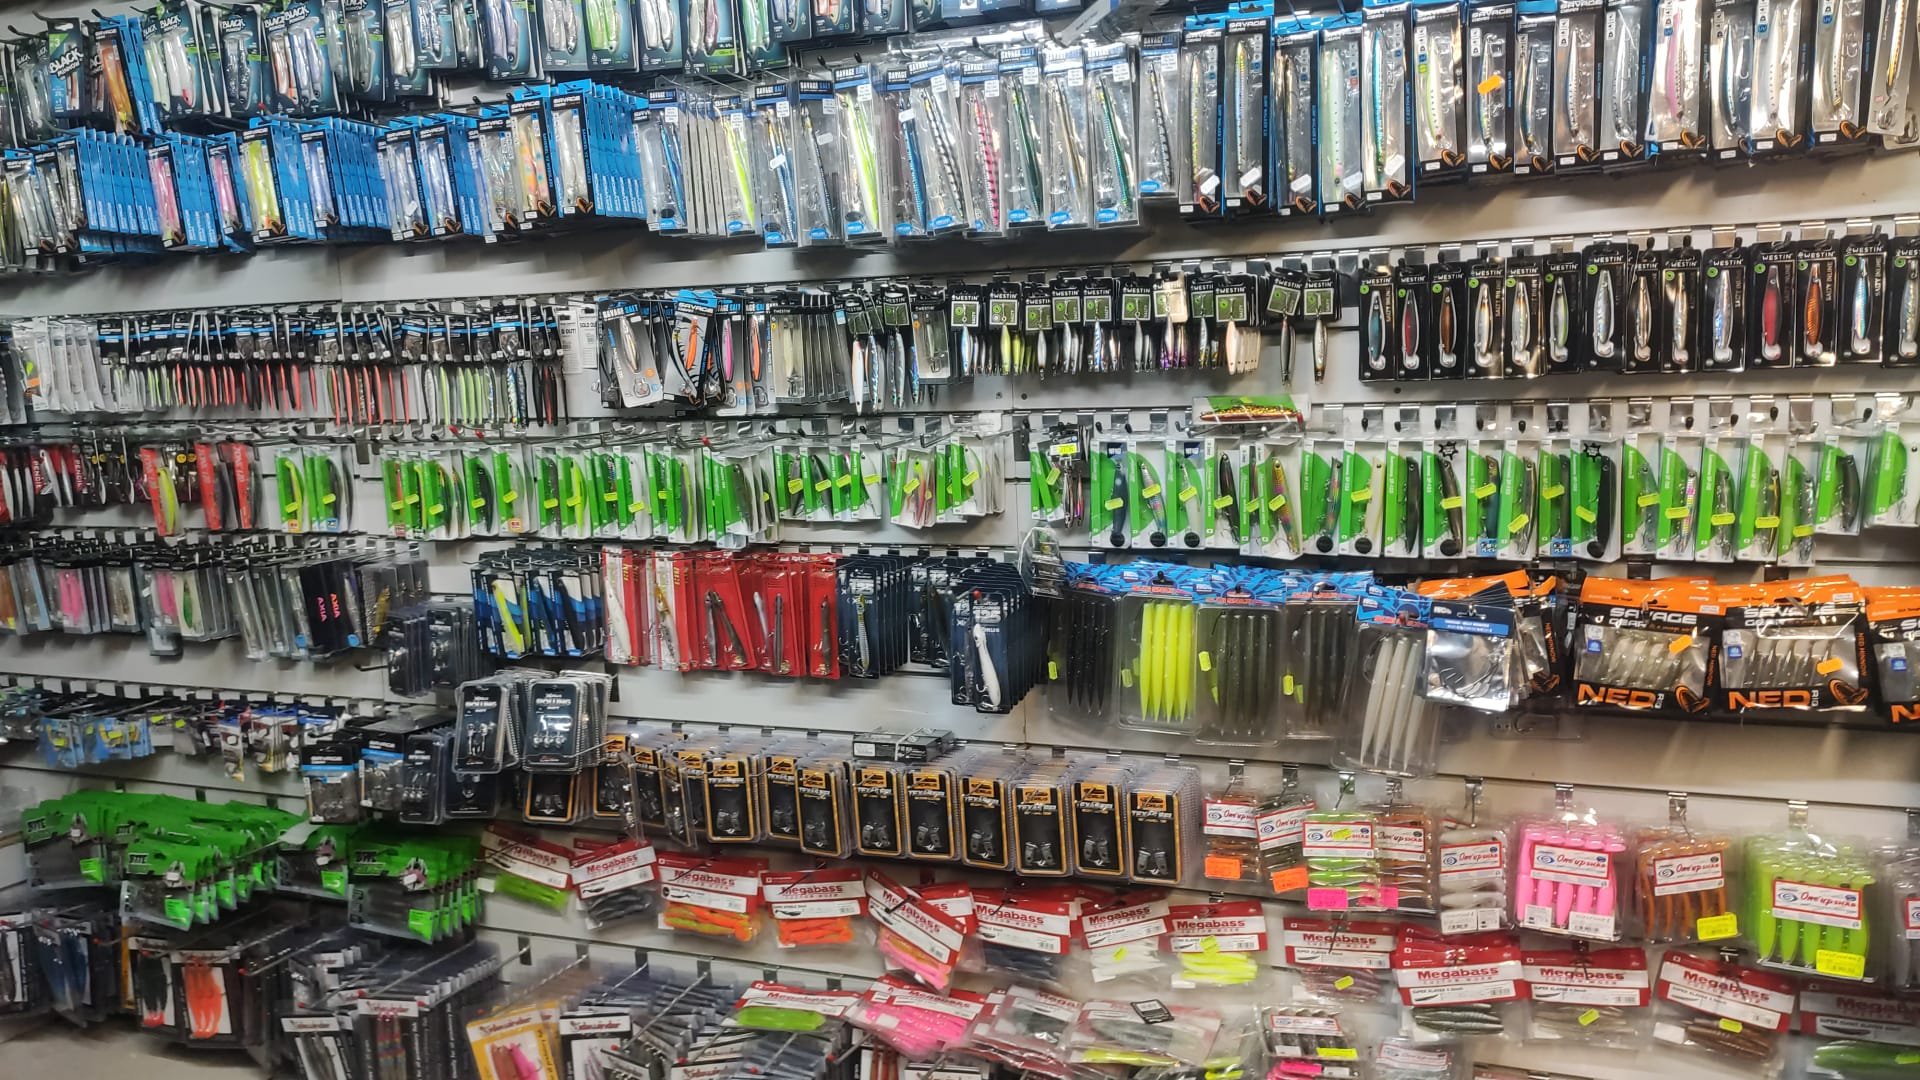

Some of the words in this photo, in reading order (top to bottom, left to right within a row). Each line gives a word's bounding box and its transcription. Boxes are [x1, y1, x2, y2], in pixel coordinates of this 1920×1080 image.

[285, 5, 309, 20] BLACK
[1472, 9, 1512, 17] SAVAGE
[160, 15, 181, 28] BLACK
[222, 18, 245, 29] BLACK
[50, 48, 84, 74] BLACK
[1804, 251, 1836, 259] WESTIN
[1851, 246, 1883, 254] WESTIN
[1594, 255, 1624, 263] WESTIN
[1713, 259, 1743, 267] WESTIN
[1762, 253, 1793, 261] WESTIN
[1671, 260, 1698, 268] WESTIN
[1437, 273, 1463, 282] WESTIN
[1475, 268, 1503, 277] WESTIN
[1510, 267, 1539, 276] WESTIN
[1278, 279, 1302, 289] WESTIN
[1366, 277, 1391, 285] WESTIN
[1400, 275, 1426, 283] WESTIN
[851, 578, 874, 595] 125
[317, 597, 327, 622] AXIA
[330, 593, 341, 619] AXIA
[973, 608, 1002, 623] 125
[1609, 618, 1647, 628] GEAR
[1578, 684, 1656, 710] NED
[1728, 690, 1811, 710] NED
[1811, 689, 1819, 707] RIG
[586, 854, 638, 875] Megabass
[674, 869, 735, 887] Megabass
[780, 885, 843, 896] Megabass
[976, 904, 1044, 925] Megabass
[1089, 906, 1151, 926] Megabass
[1176, 919, 1246, 931] Megabass
[1303, 933, 1377, 946] Megabass
[1417, 967, 1500, 981] Megabass
[1540, 967, 1626, 982] Megabass
[1682, 970, 1771, 1003] Megabass
